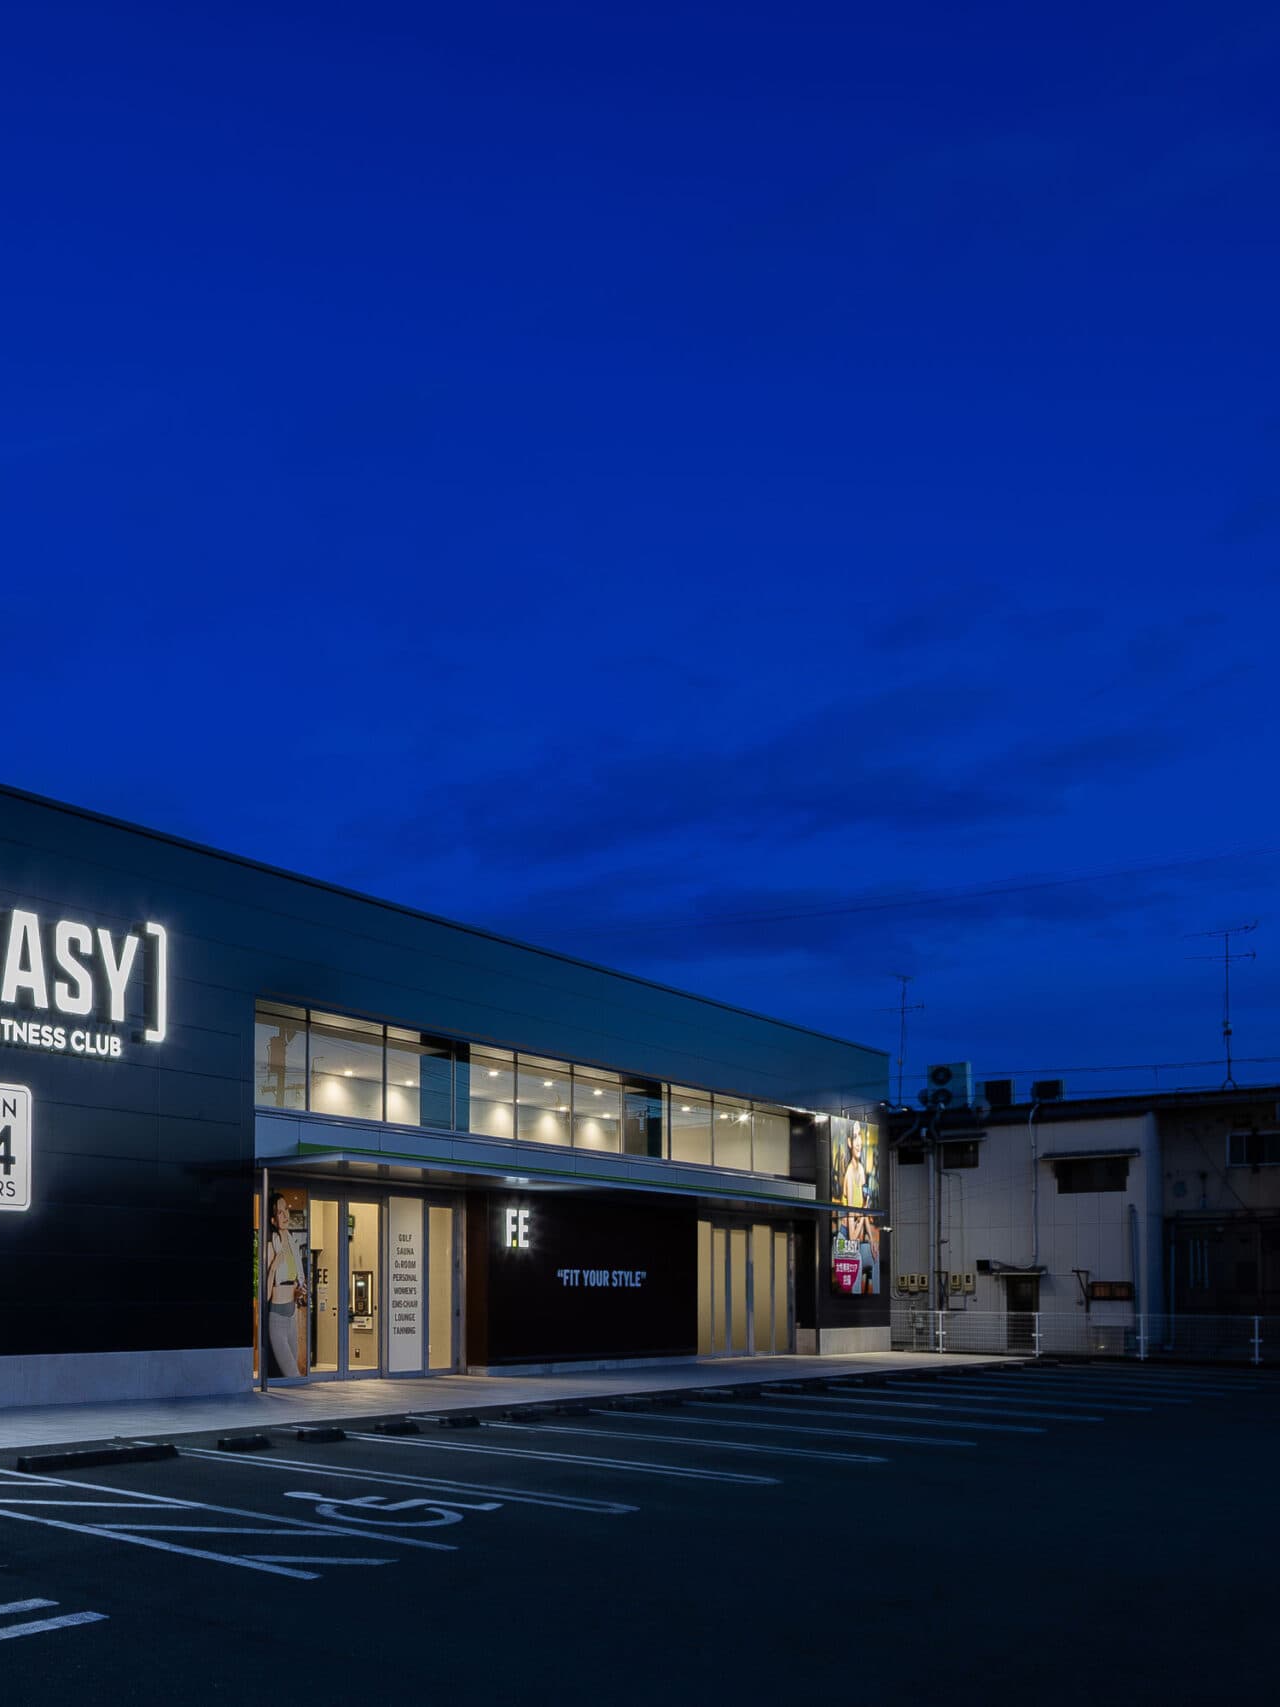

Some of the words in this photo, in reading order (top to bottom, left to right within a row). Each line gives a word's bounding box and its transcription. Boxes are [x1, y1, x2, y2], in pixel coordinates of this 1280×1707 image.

[70, 1030, 122, 1057] CLUB
[396, 1247, 414, 1255] SAUNA
[393, 1274, 417, 1282] PERSONAL
[582, 1270, 610, 1287] YOUR
[395, 1313, 415, 1322] LOUNGE
